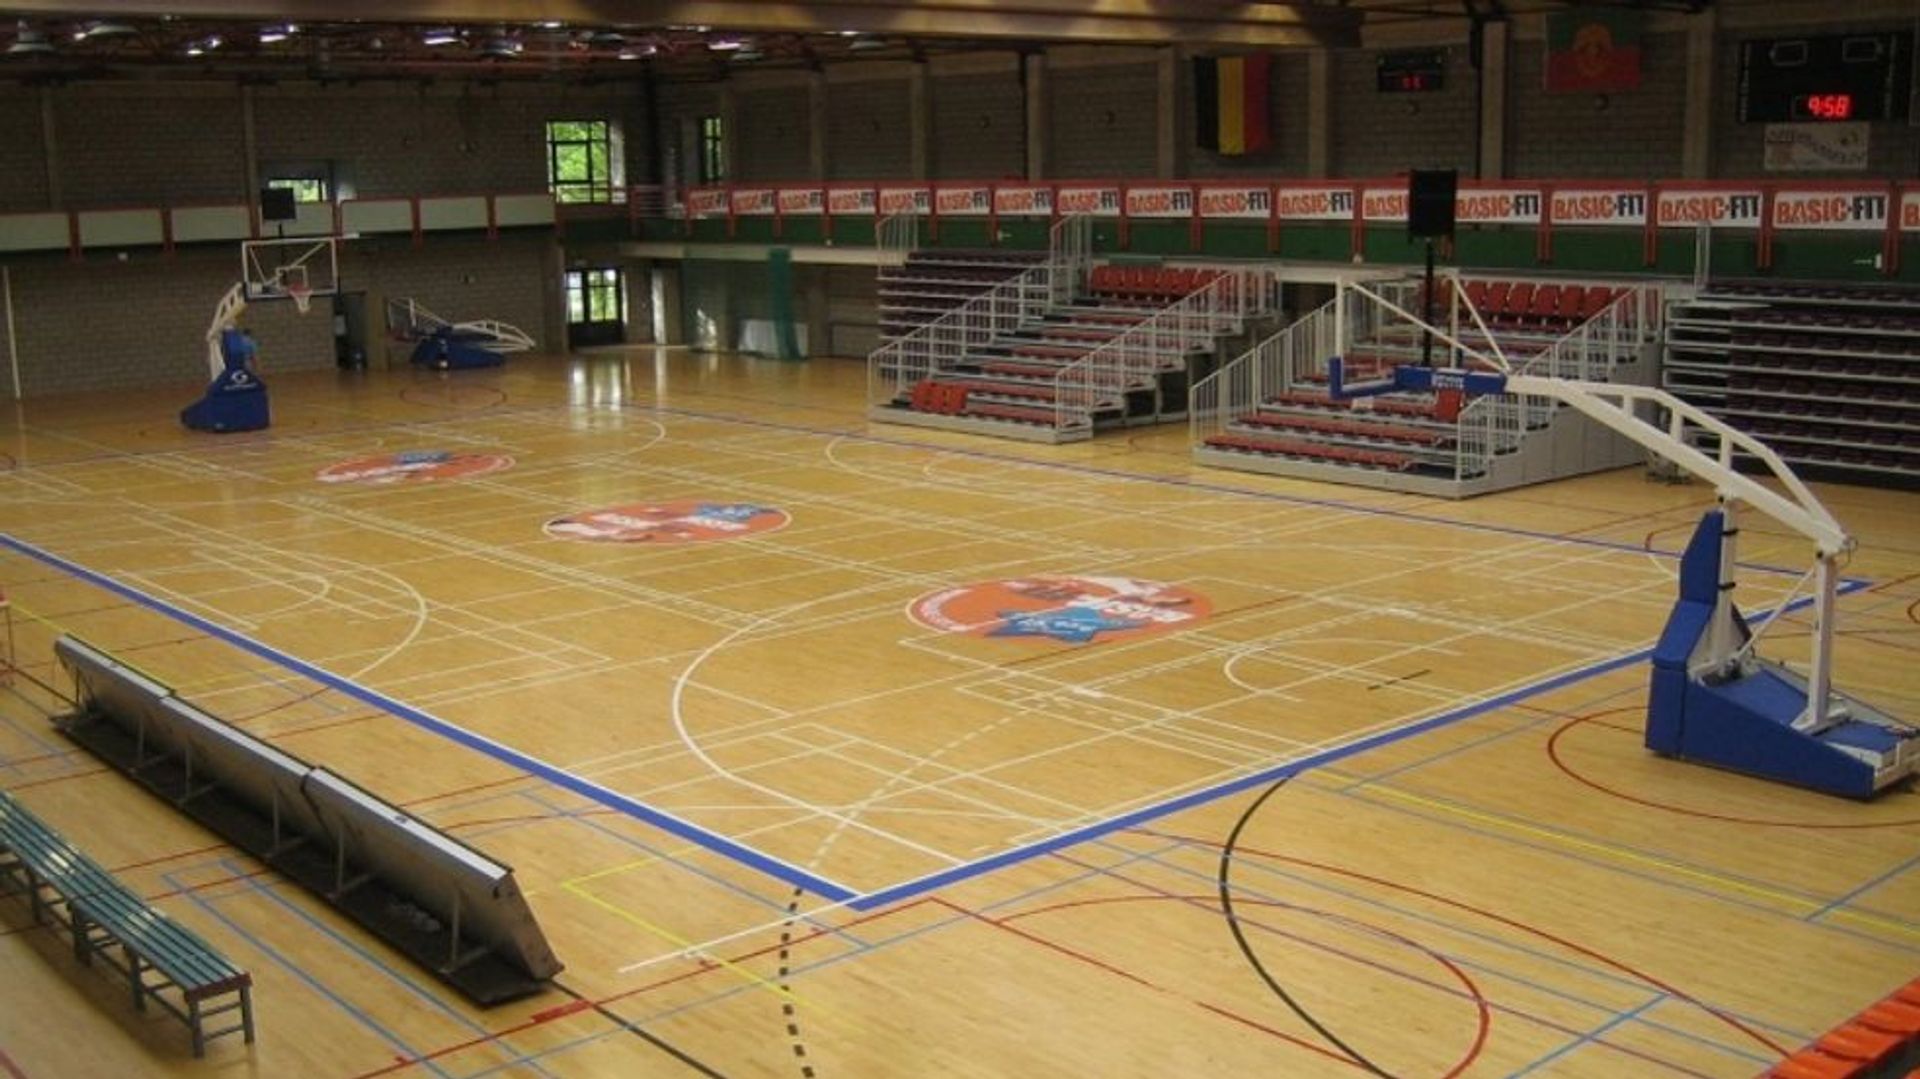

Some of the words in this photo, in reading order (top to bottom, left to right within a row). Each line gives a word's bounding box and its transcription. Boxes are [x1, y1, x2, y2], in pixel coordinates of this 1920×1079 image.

[1808, 94, 1850, 118] 9:58
[1281, 191, 1351, 215] BASIC-FIT
[1554, 194, 1643, 220] BASIC-FIT
[1660, 195, 1760, 222] BASIC-FIT
[1776, 195, 1886, 224] BASIC-FIT
